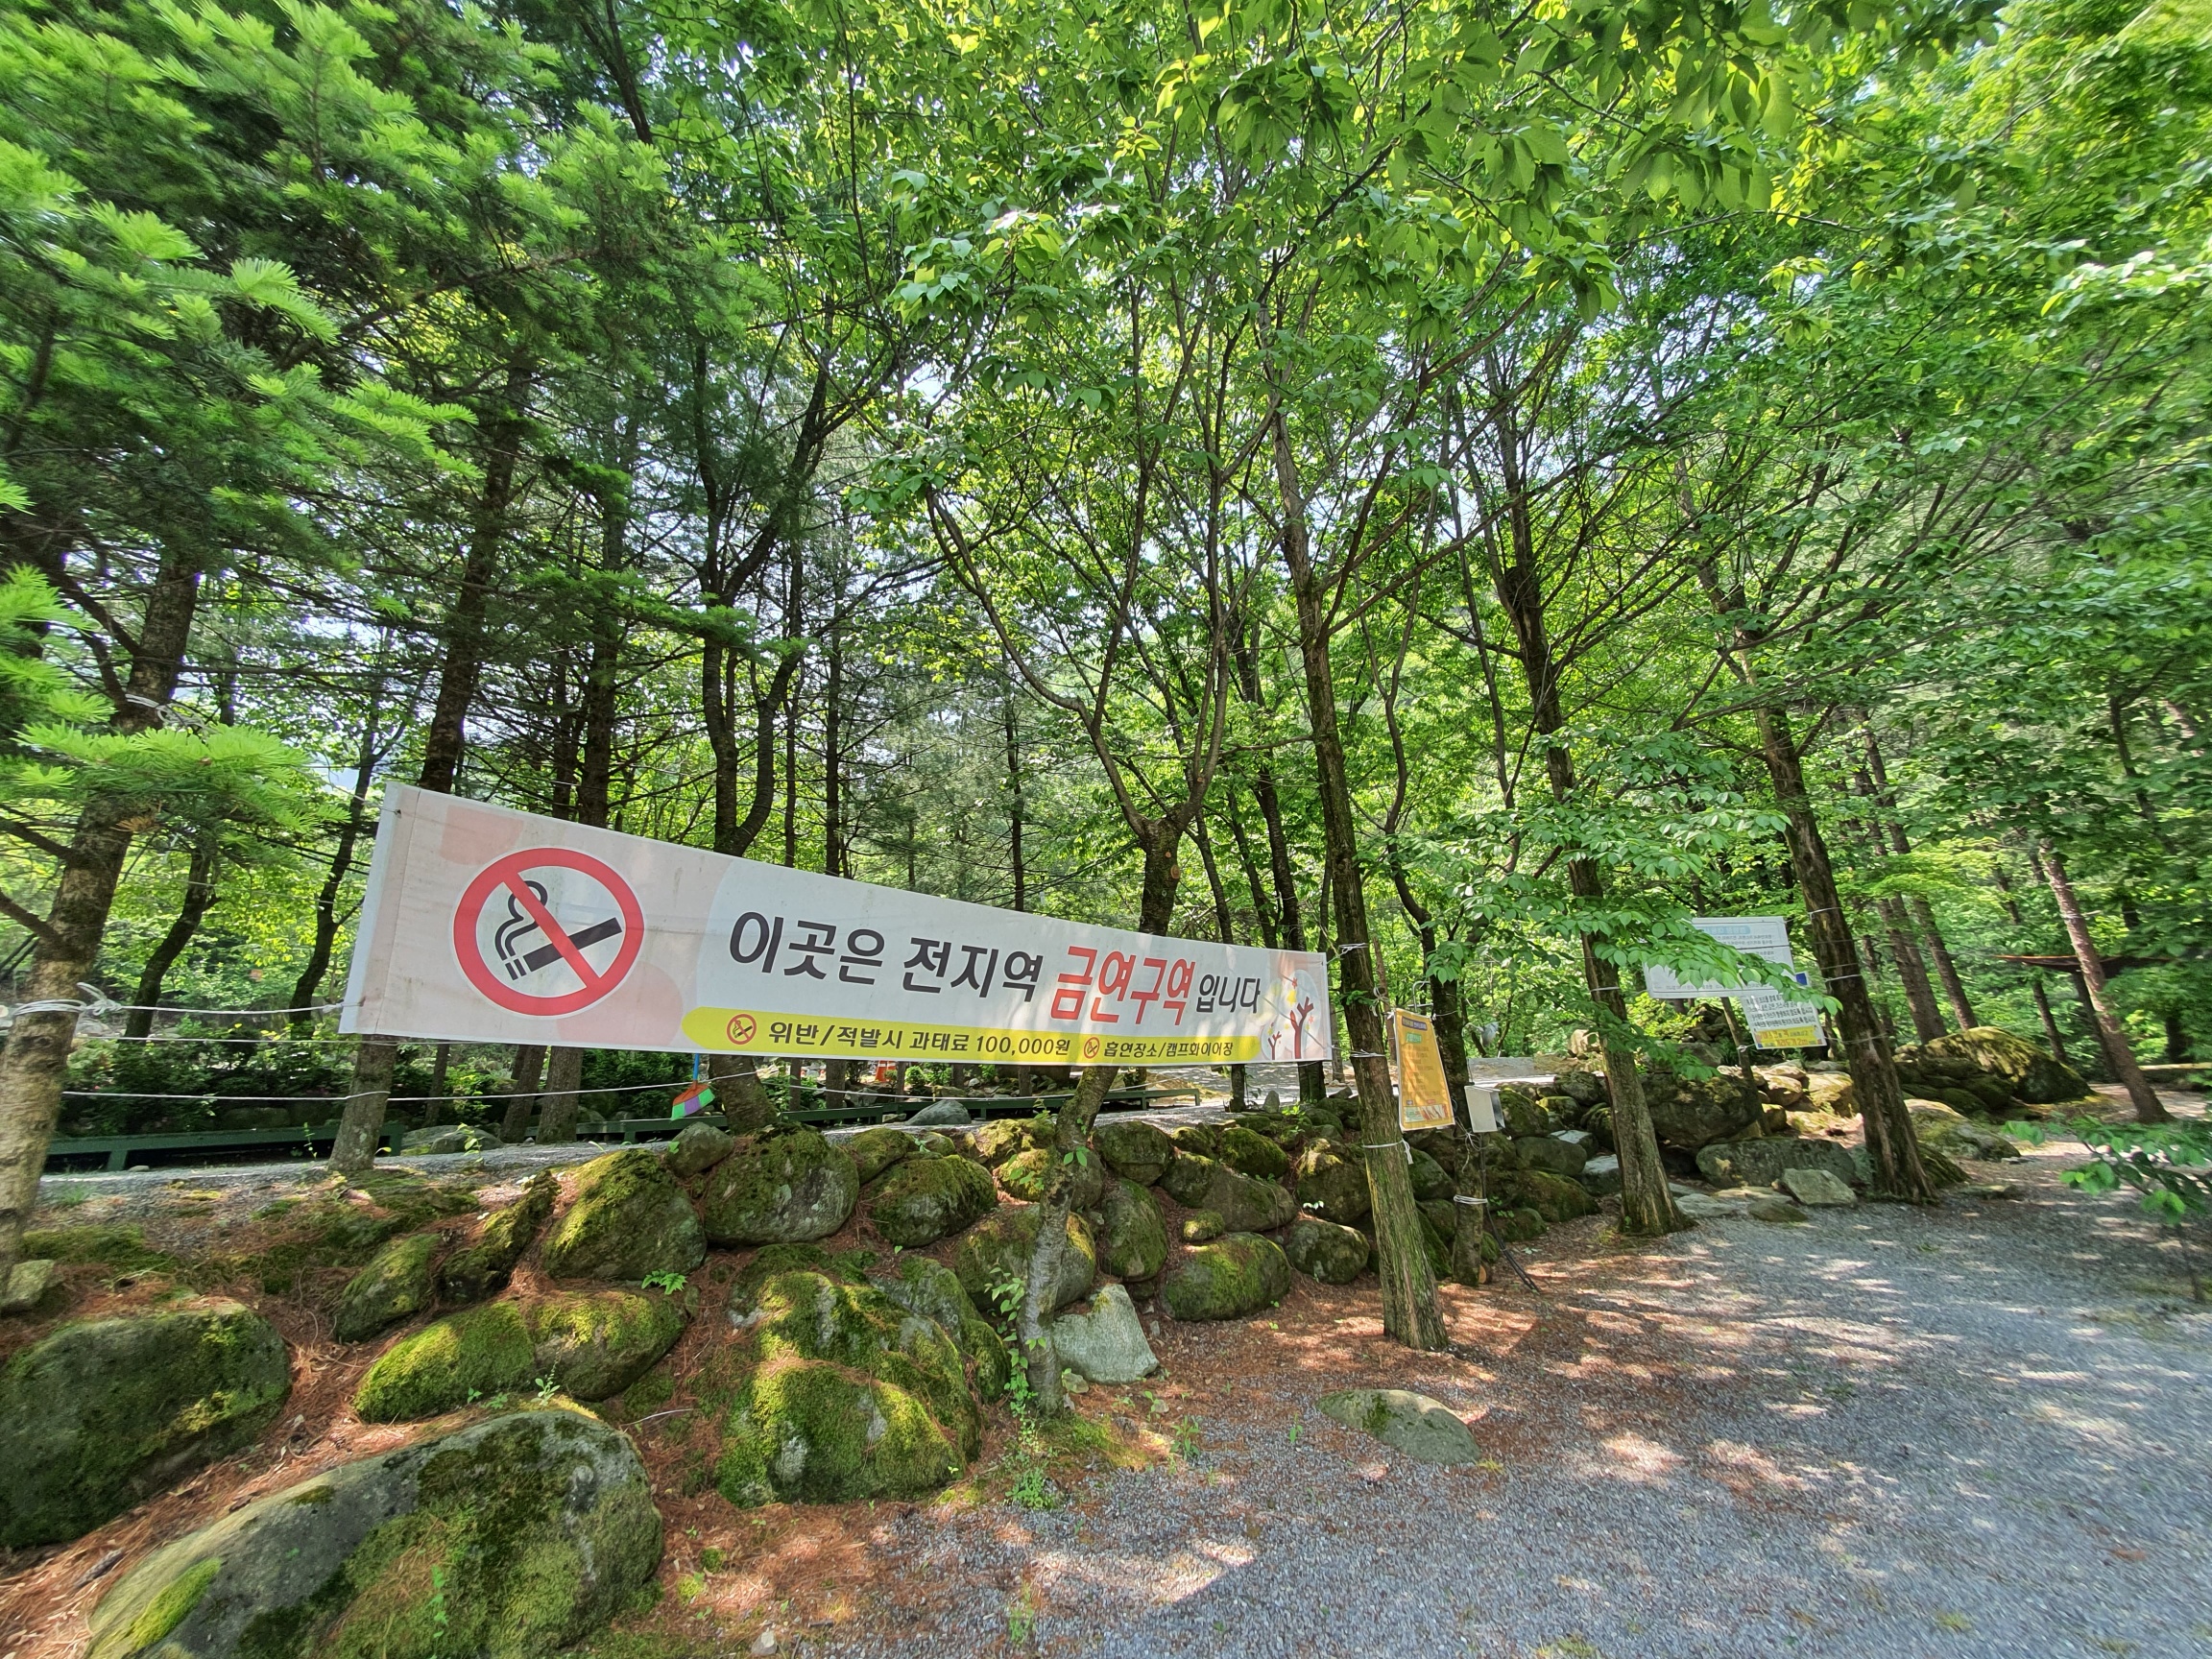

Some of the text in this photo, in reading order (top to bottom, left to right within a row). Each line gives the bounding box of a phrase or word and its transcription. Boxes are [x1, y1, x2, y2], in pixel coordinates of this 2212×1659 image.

[729, 911, 1261, 1025] 이곳은 전지역 금연구역 입니다
[768, 1022, 1071, 1056] 위반/적발시 과태료 100,000원
